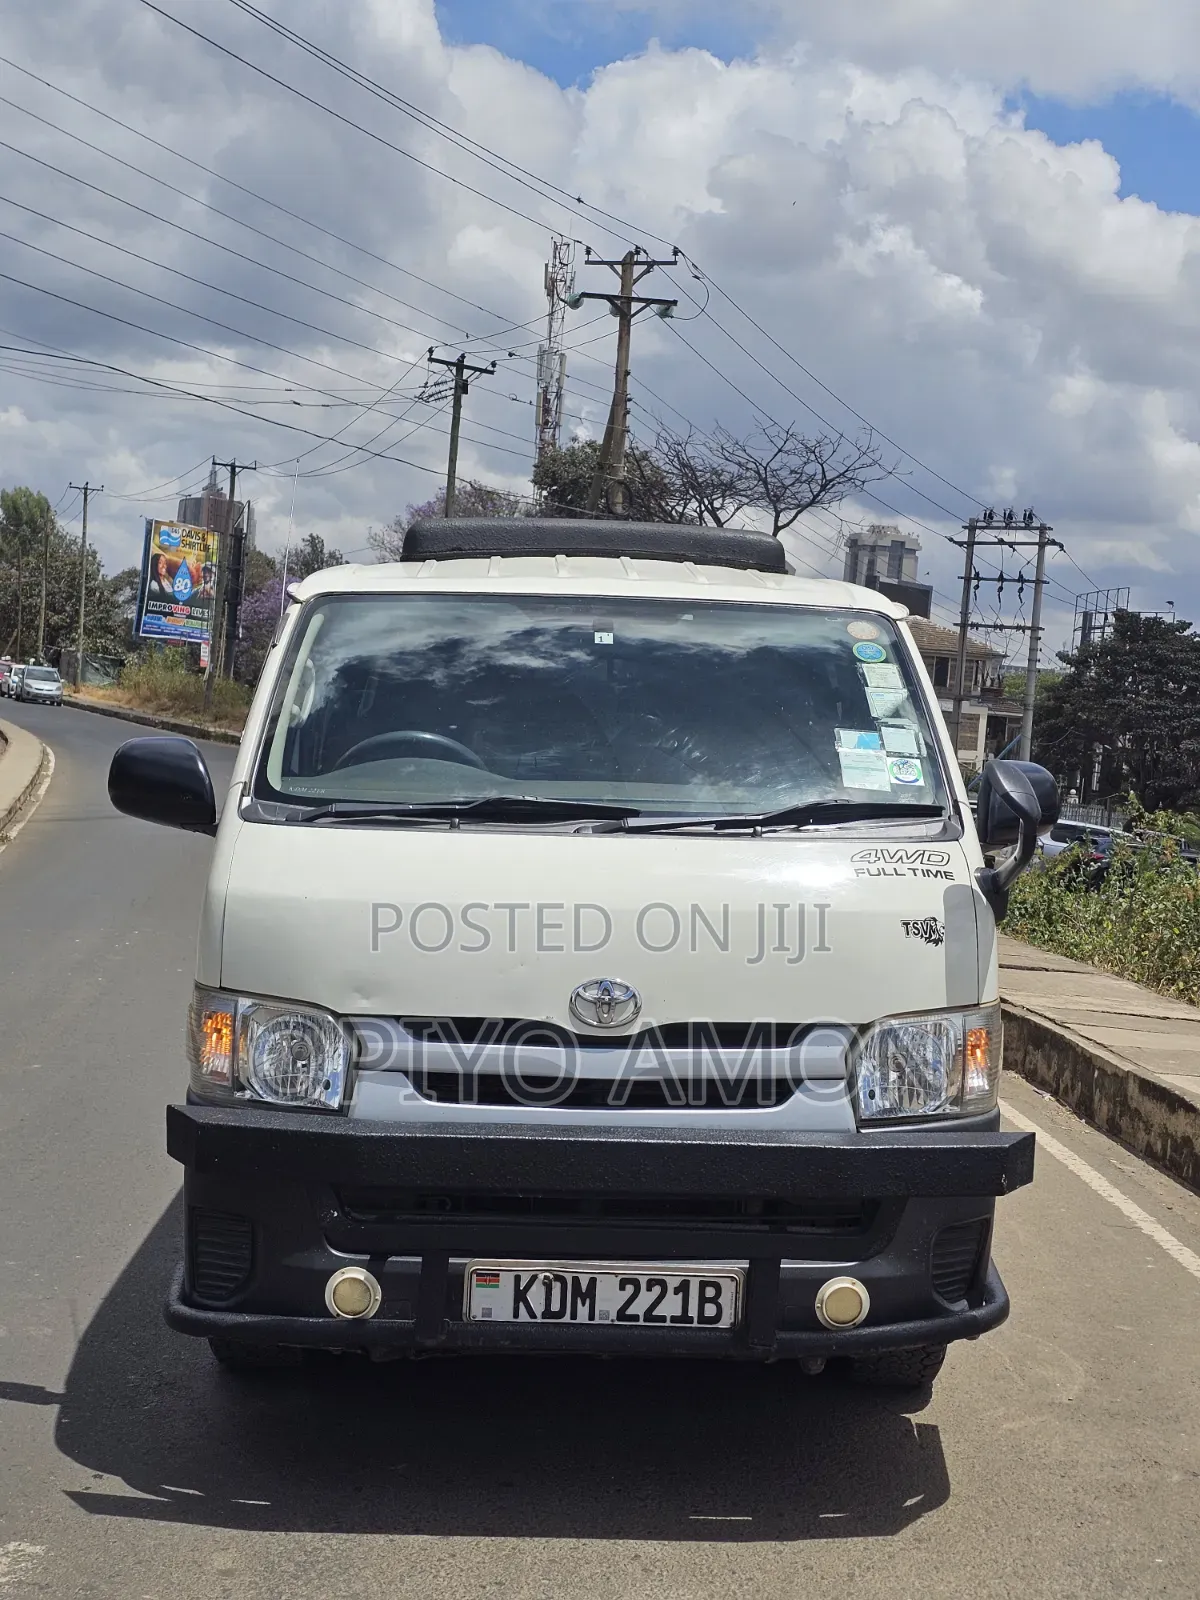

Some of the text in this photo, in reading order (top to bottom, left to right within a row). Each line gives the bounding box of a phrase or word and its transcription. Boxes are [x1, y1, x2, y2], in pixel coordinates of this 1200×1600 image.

[181, 528, 206, 542] DAVIS &
[174, 577, 191, 594] 80
[147, 601, 191, 615] IMPROVING
[850, 849, 951, 867] 4WD
[854, 867, 956, 881] FULL TIME
[512, 1273, 598, 1322] KDM
[615, 1277, 724, 1325] 221B
